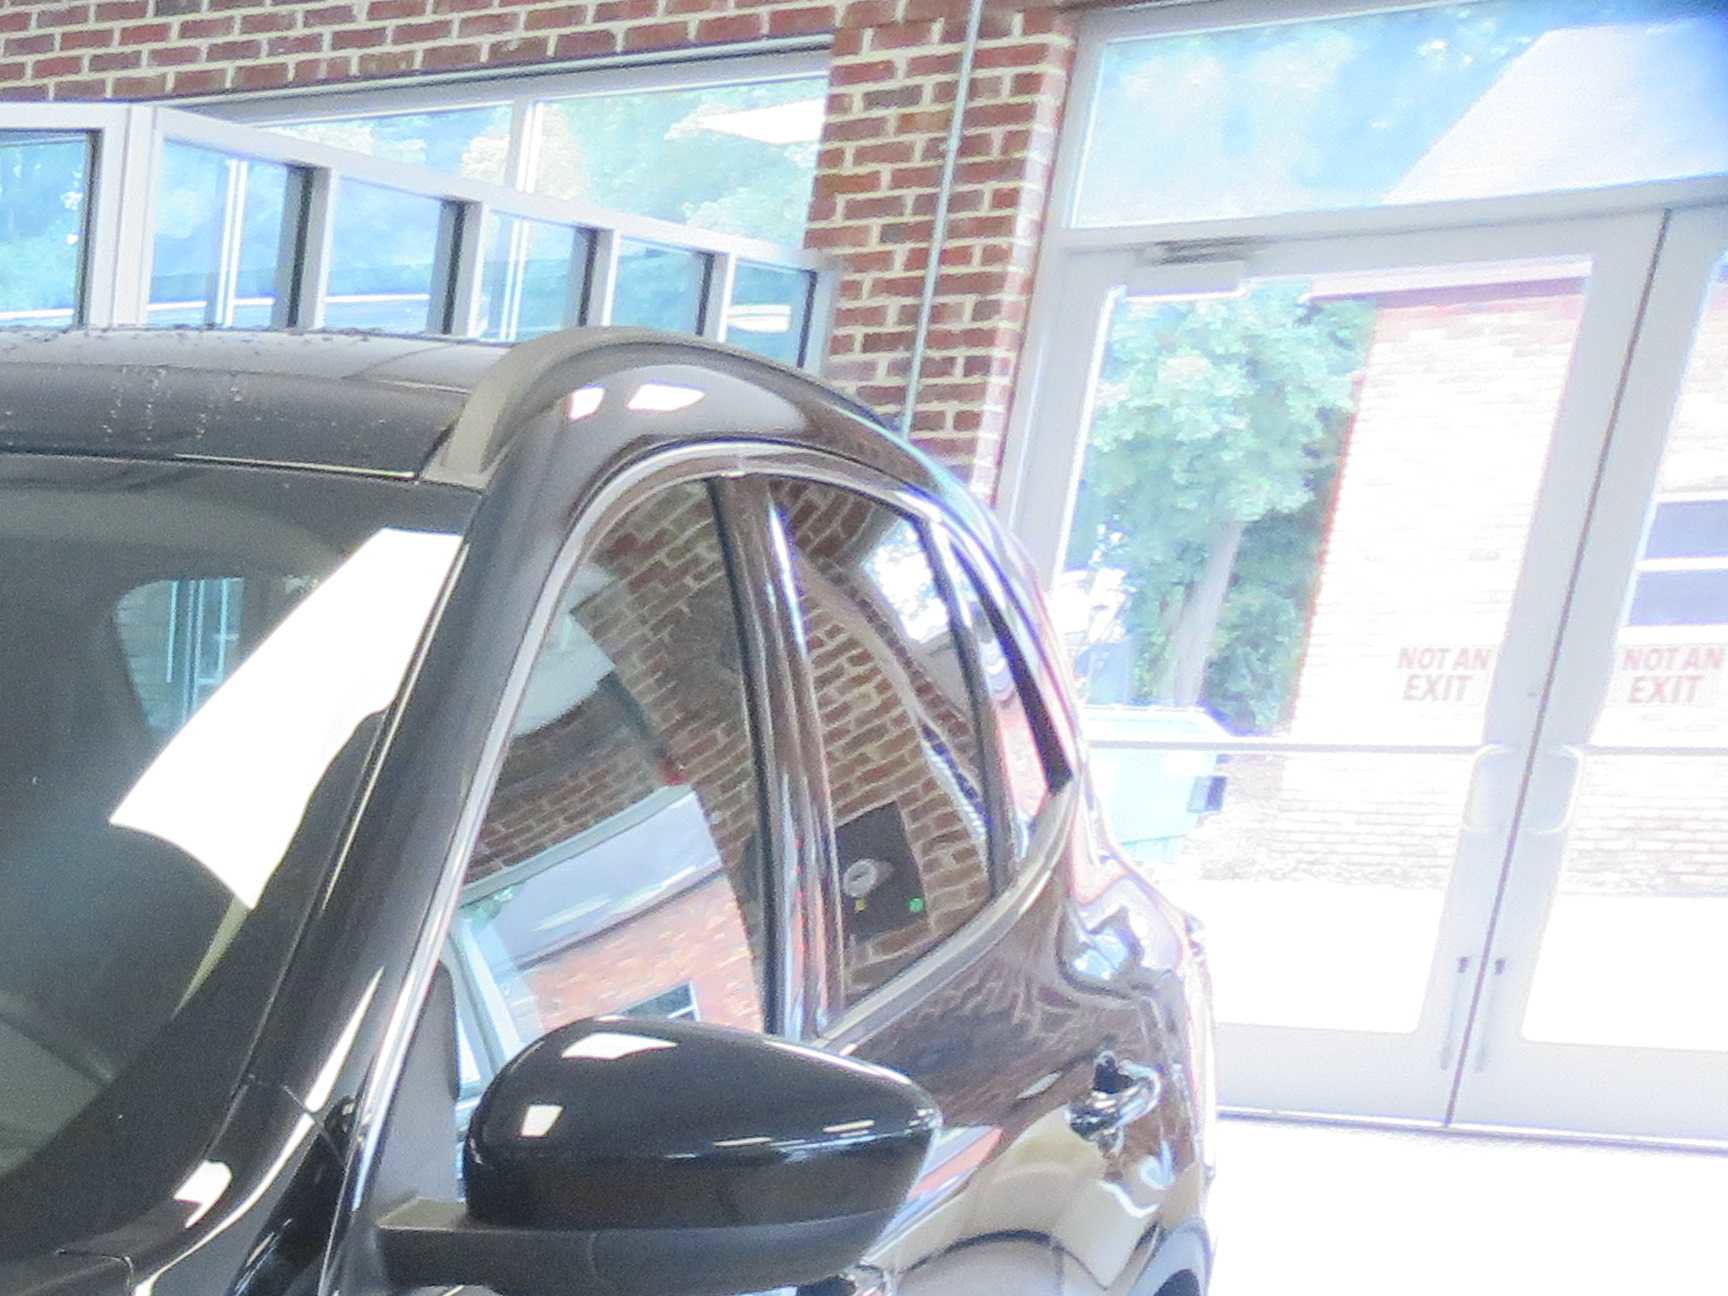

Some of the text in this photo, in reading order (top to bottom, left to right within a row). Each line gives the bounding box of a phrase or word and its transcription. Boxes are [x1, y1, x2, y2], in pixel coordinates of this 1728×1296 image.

[1397, 647, 1492, 670] NOT AN
[1622, 647, 1724, 671] NOT AN
[1402, 673, 1473, 702] EXIT
[1627, 674, 1704, 703] EXIT
